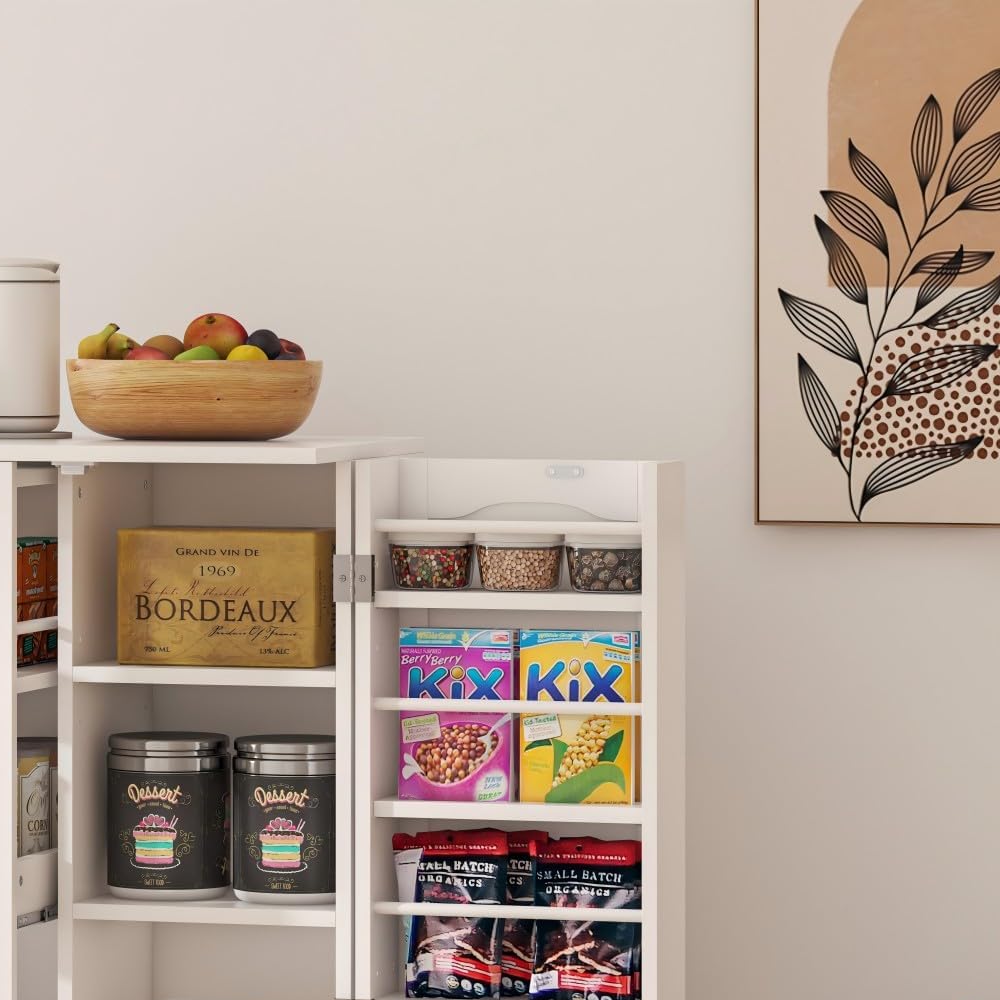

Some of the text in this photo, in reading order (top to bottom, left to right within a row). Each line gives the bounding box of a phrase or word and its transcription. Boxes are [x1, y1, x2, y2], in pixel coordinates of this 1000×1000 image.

[175, 547, 217, 557] GRAND
[200, 565, 236, 577] 1969
[135, 594, 297, 623] BORDEAUX
[401, 653, 462, 666] Berry Berry
[127, 783, 183, 804] Dessert
[254, 786, 310, 808] Dessert
[454, 860, 495, 874] BATCH
[418, 875, 482, 888] ORGANICS
[537, 870, 622, 883] SMALL BATCH
[546, 885, 610, 897] ORGANICS
